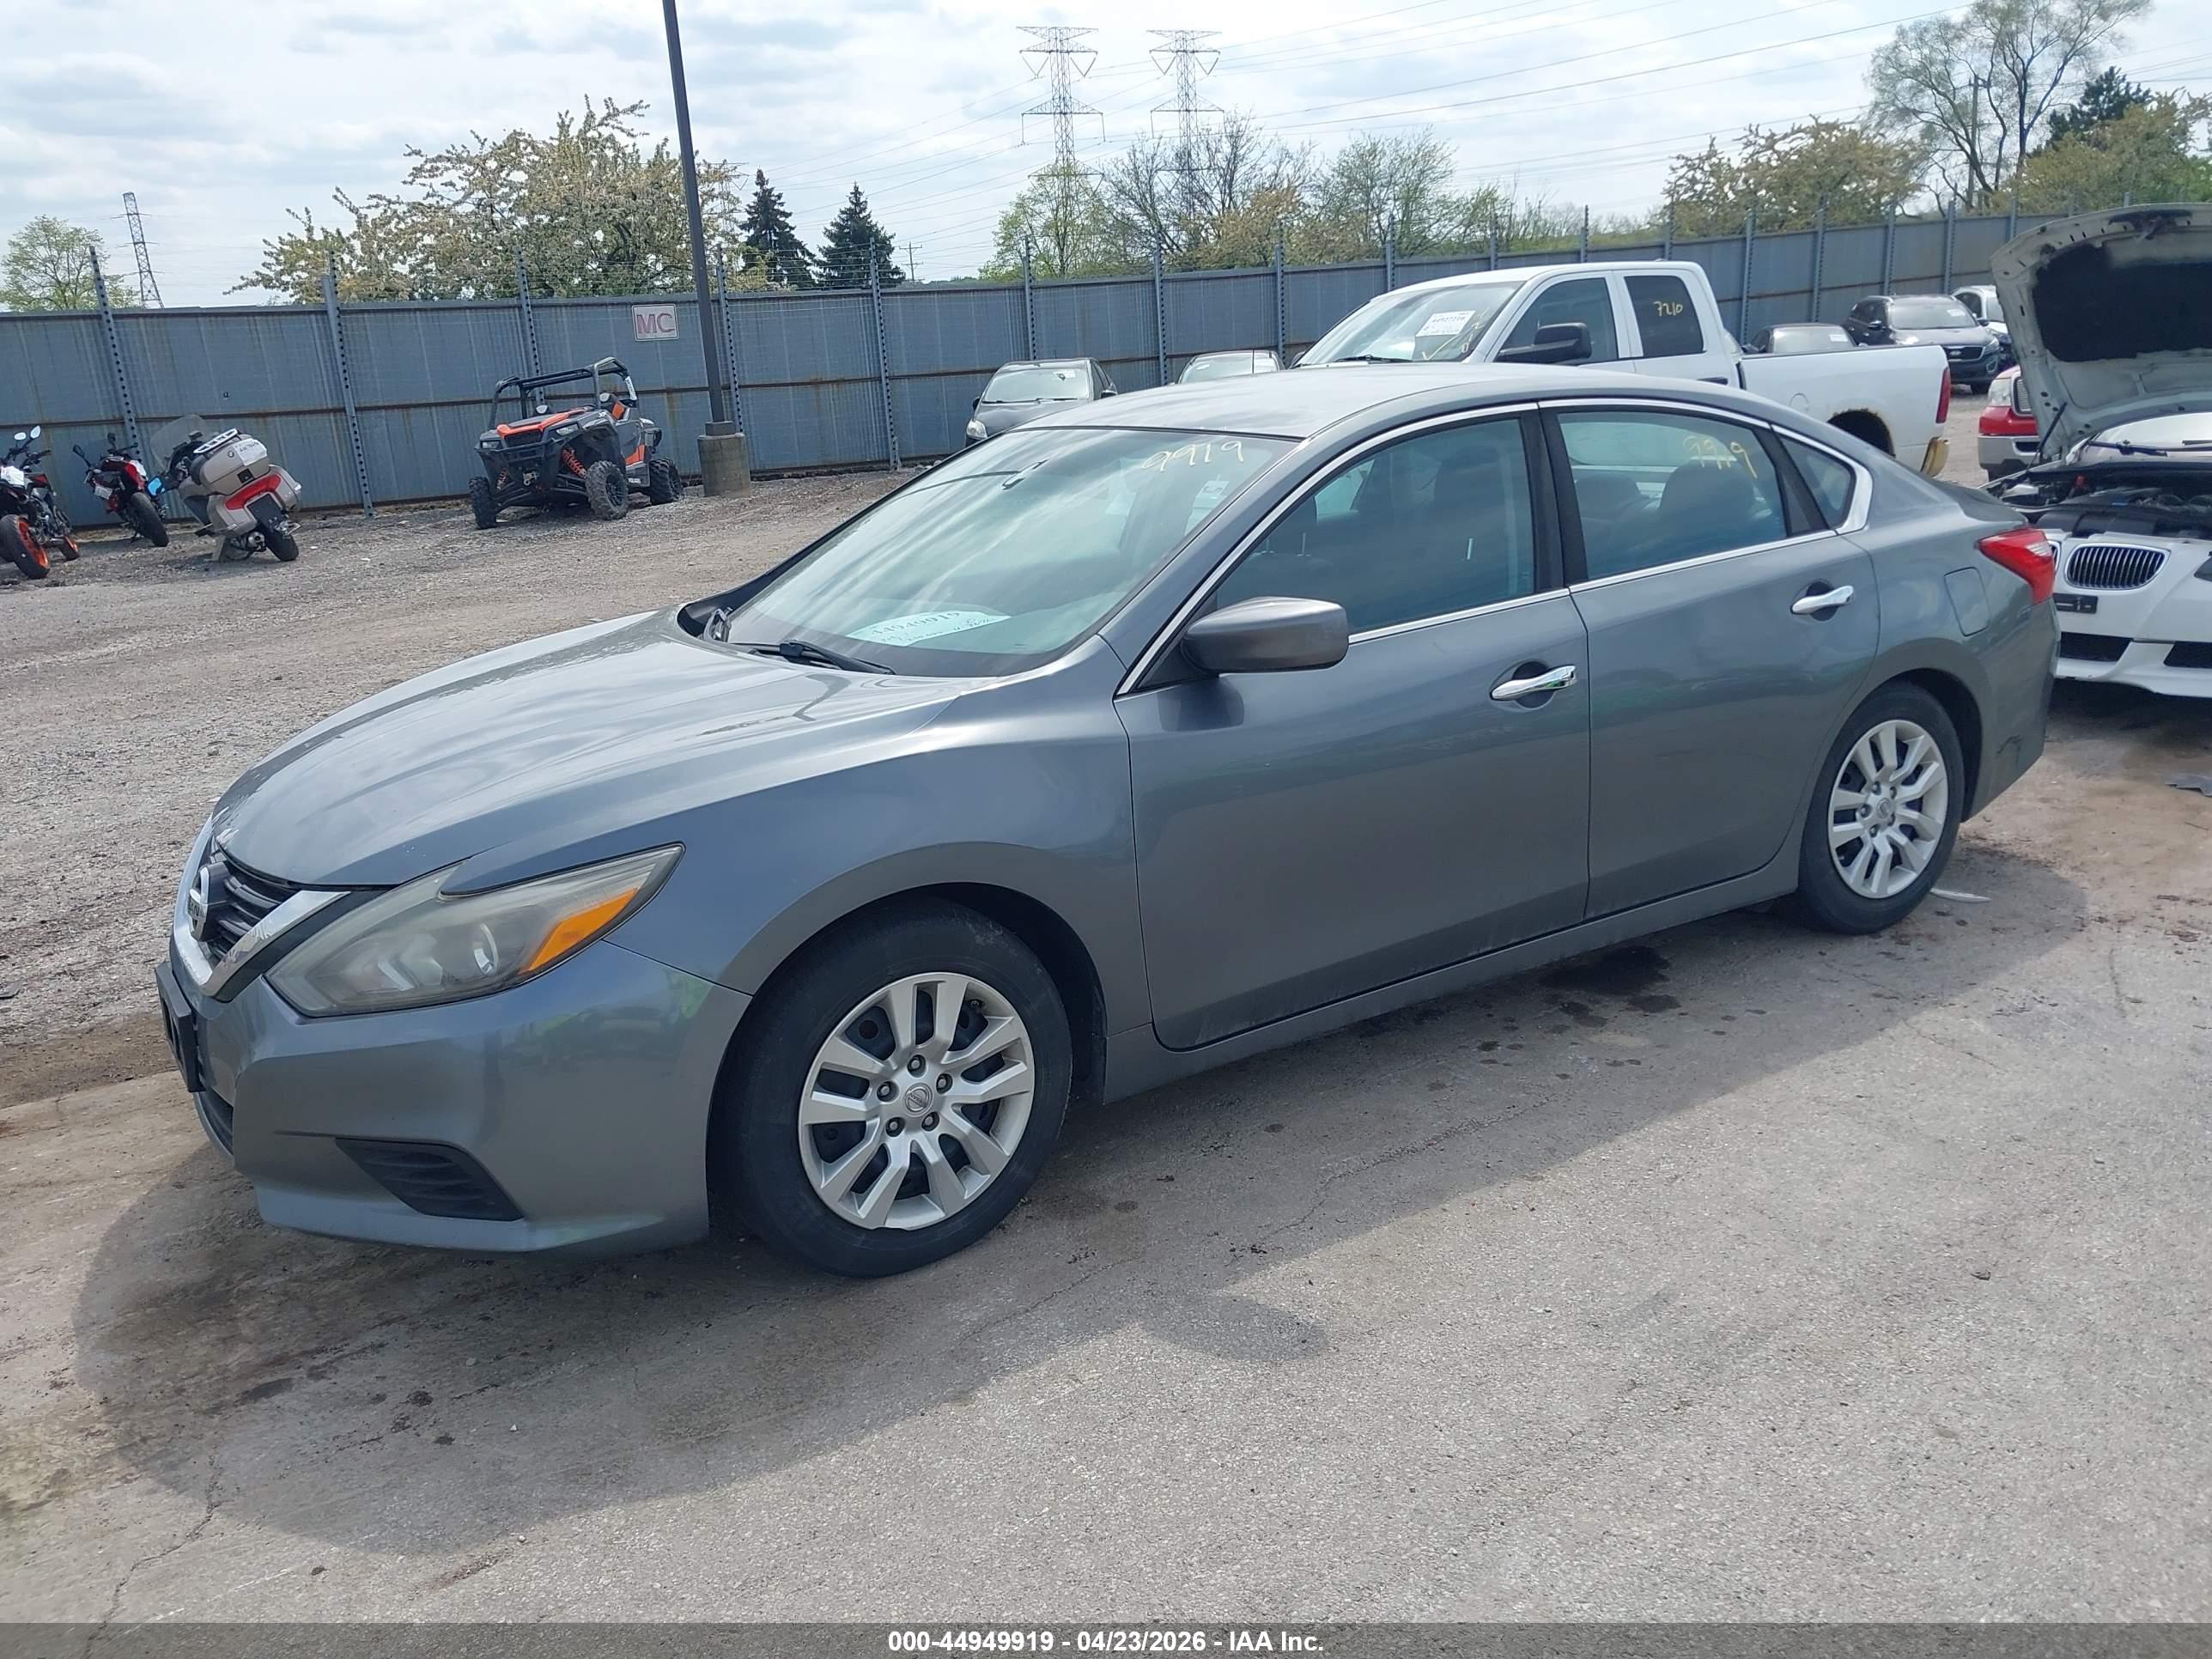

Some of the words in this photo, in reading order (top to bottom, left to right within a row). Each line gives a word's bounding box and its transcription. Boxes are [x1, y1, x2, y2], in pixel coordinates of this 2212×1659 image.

[1653, 301, 1684, 317] 7210
[636, 313, 675, 333] MC
[1140, 441, 1244, 472] 9919
